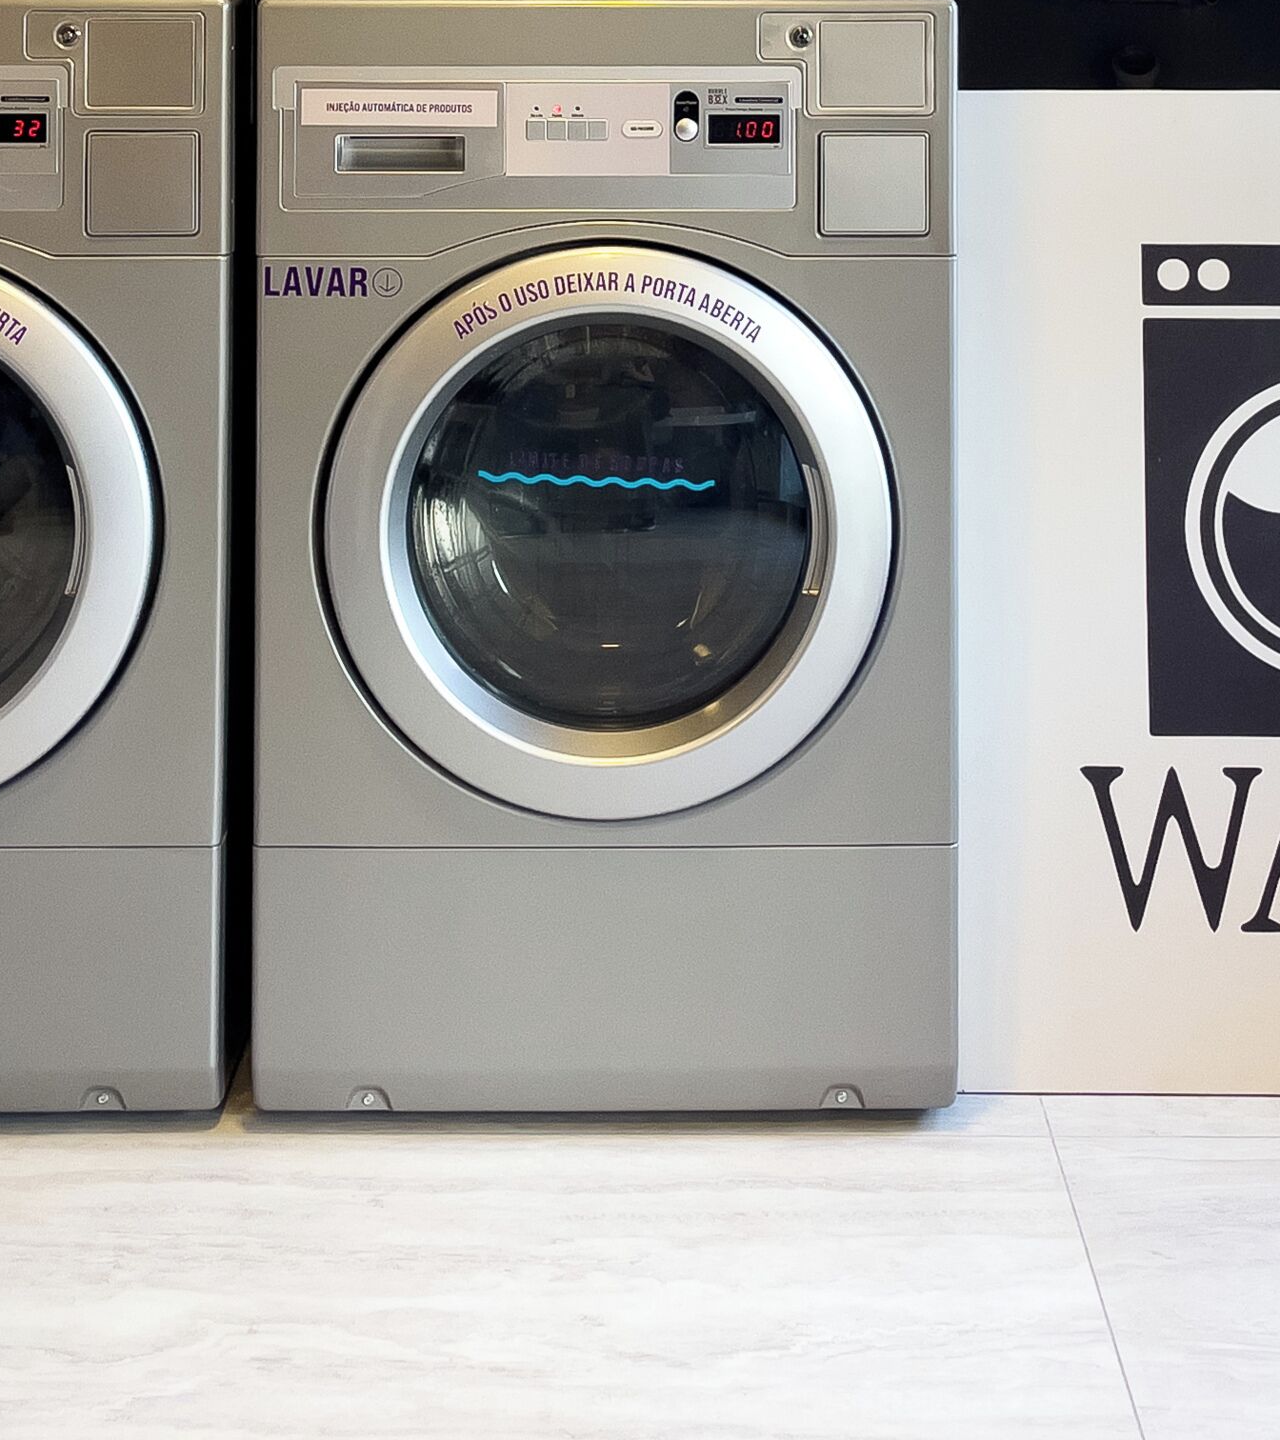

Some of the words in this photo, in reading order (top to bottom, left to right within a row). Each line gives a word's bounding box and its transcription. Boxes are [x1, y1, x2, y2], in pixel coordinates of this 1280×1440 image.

[326, 101, 360, 113] INJEÇÃO
[362, 101, 414, 112] AUTOMÁTICA
[416, 103, 427, 112] DE
[429, 104, 473, 113] PRODUTOS
[14, 120, 41, 136] 32
[265, 266, 367, 297] LAVAR
[453, 300, 497, 339] APÓS
[498, 293, 512, 312] O
[514, 280, 550, 307] USO
[554, 271, 618, 294] DEIXAR
[624, 273, 635, 292] A
[641, 275, 695, 307] PORTA
[698, 293, 762, 343] ABERTA
